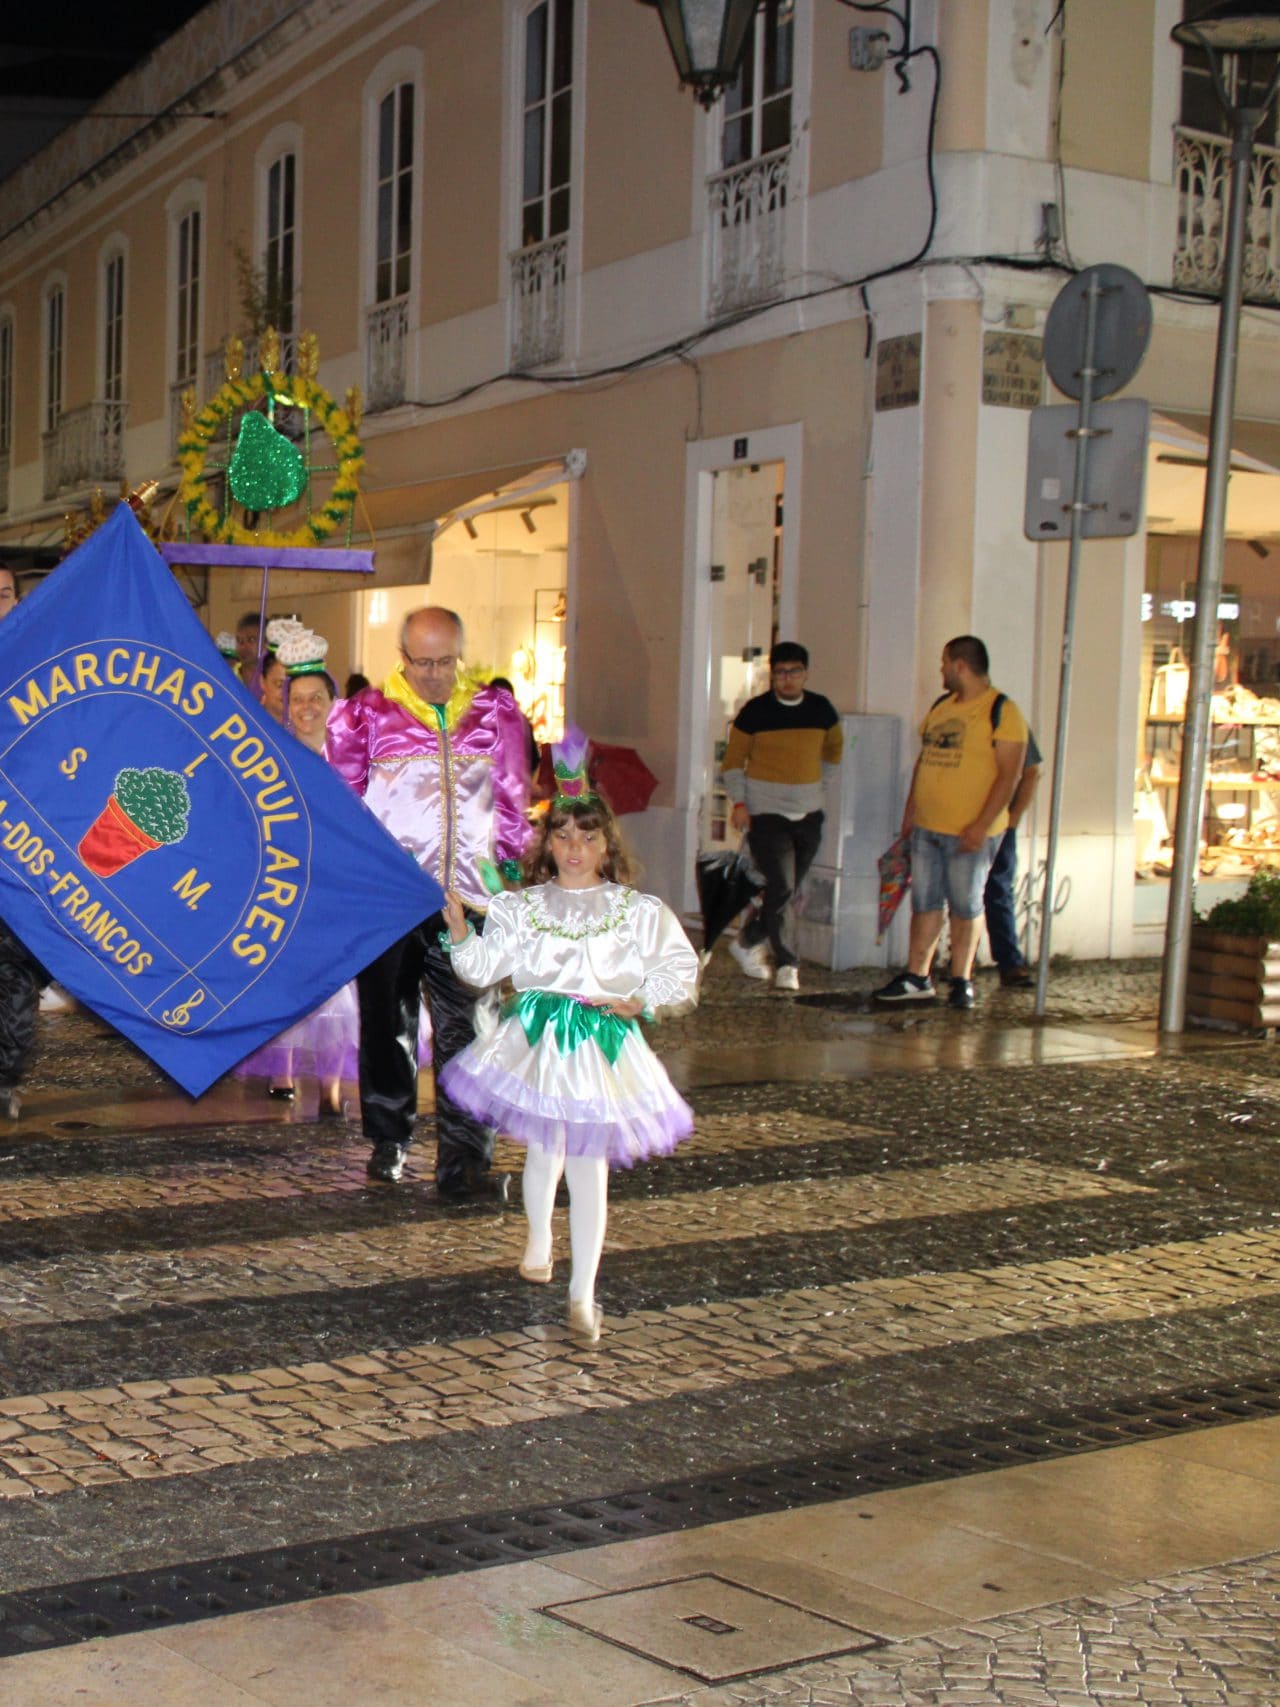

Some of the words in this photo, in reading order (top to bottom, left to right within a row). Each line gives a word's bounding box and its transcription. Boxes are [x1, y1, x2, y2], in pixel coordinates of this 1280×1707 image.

[60, 747, 88, 780] S.
[183, 752, 209, 778] I.
[8, 648, 214, 725] MARCHAS
[210, 713, 300, 966] POPULARES
[172, 868, 212, 911] M.
